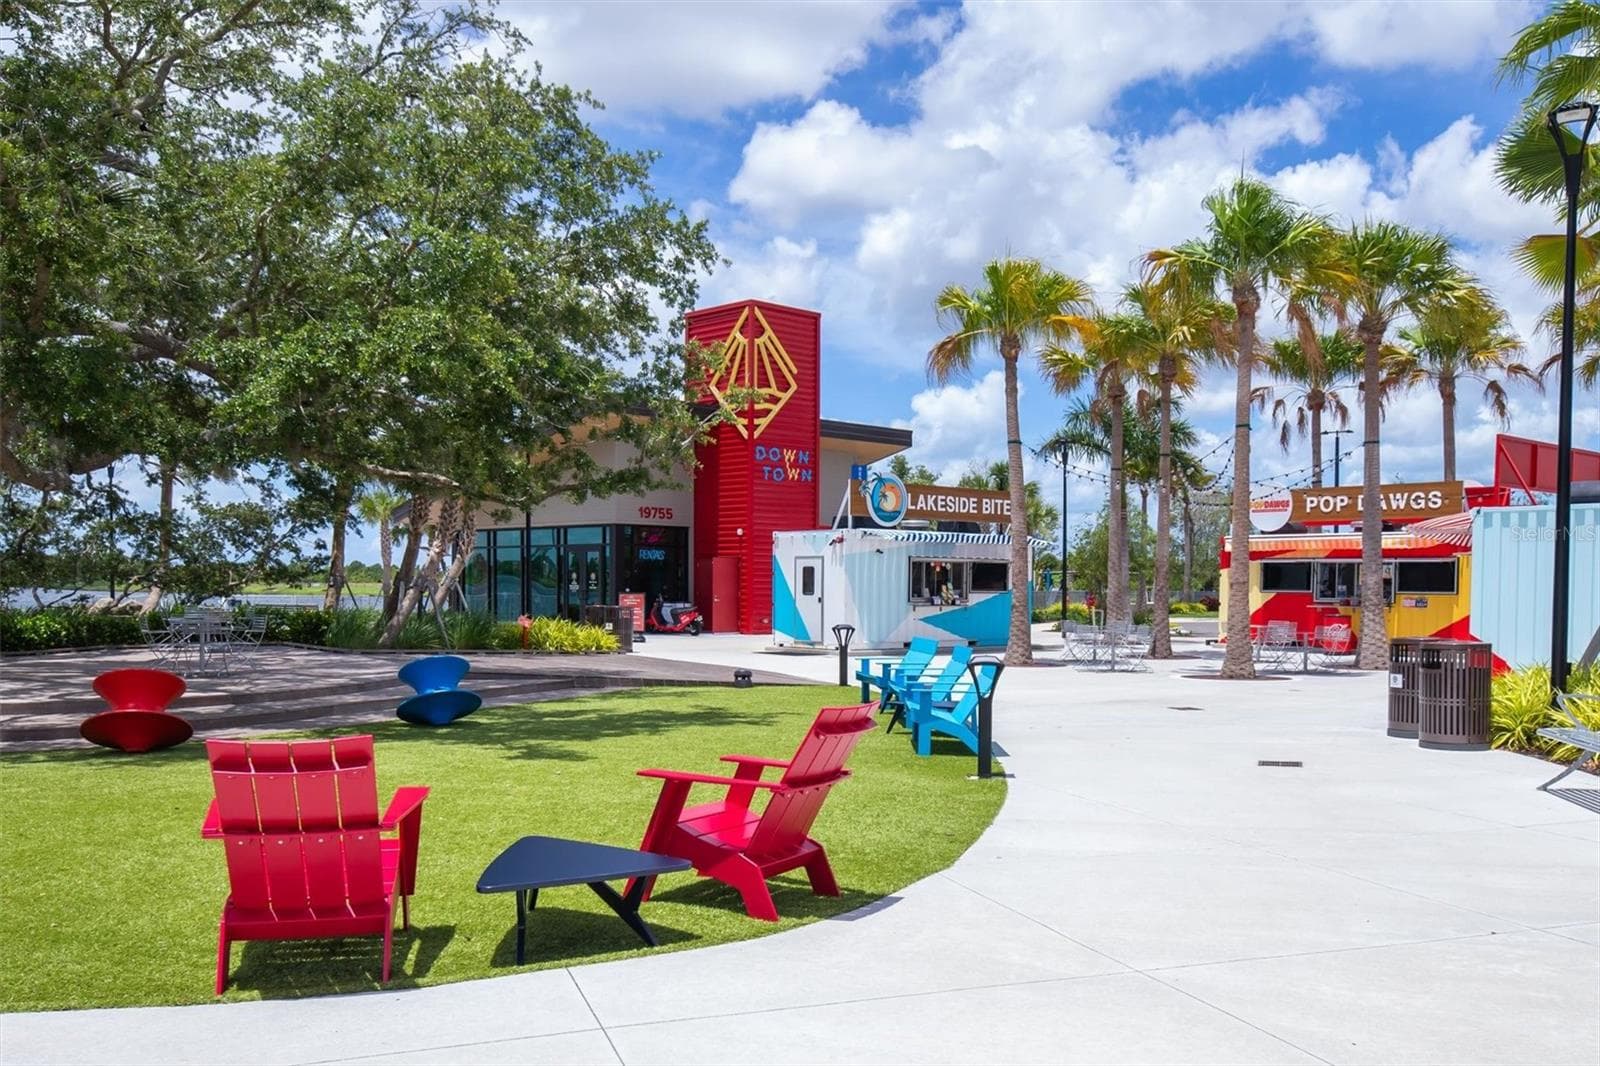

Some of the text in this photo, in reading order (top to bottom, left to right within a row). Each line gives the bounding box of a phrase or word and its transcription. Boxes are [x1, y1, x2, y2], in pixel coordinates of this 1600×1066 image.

[755, 446, 810, 464] DOWN
[763, 466, 813, 481] TOWN
[907, 493, 977, 514] LAKESIDE
[1306, 495, 1348, 513] POP
[638, 506, 673, 520] 19755
